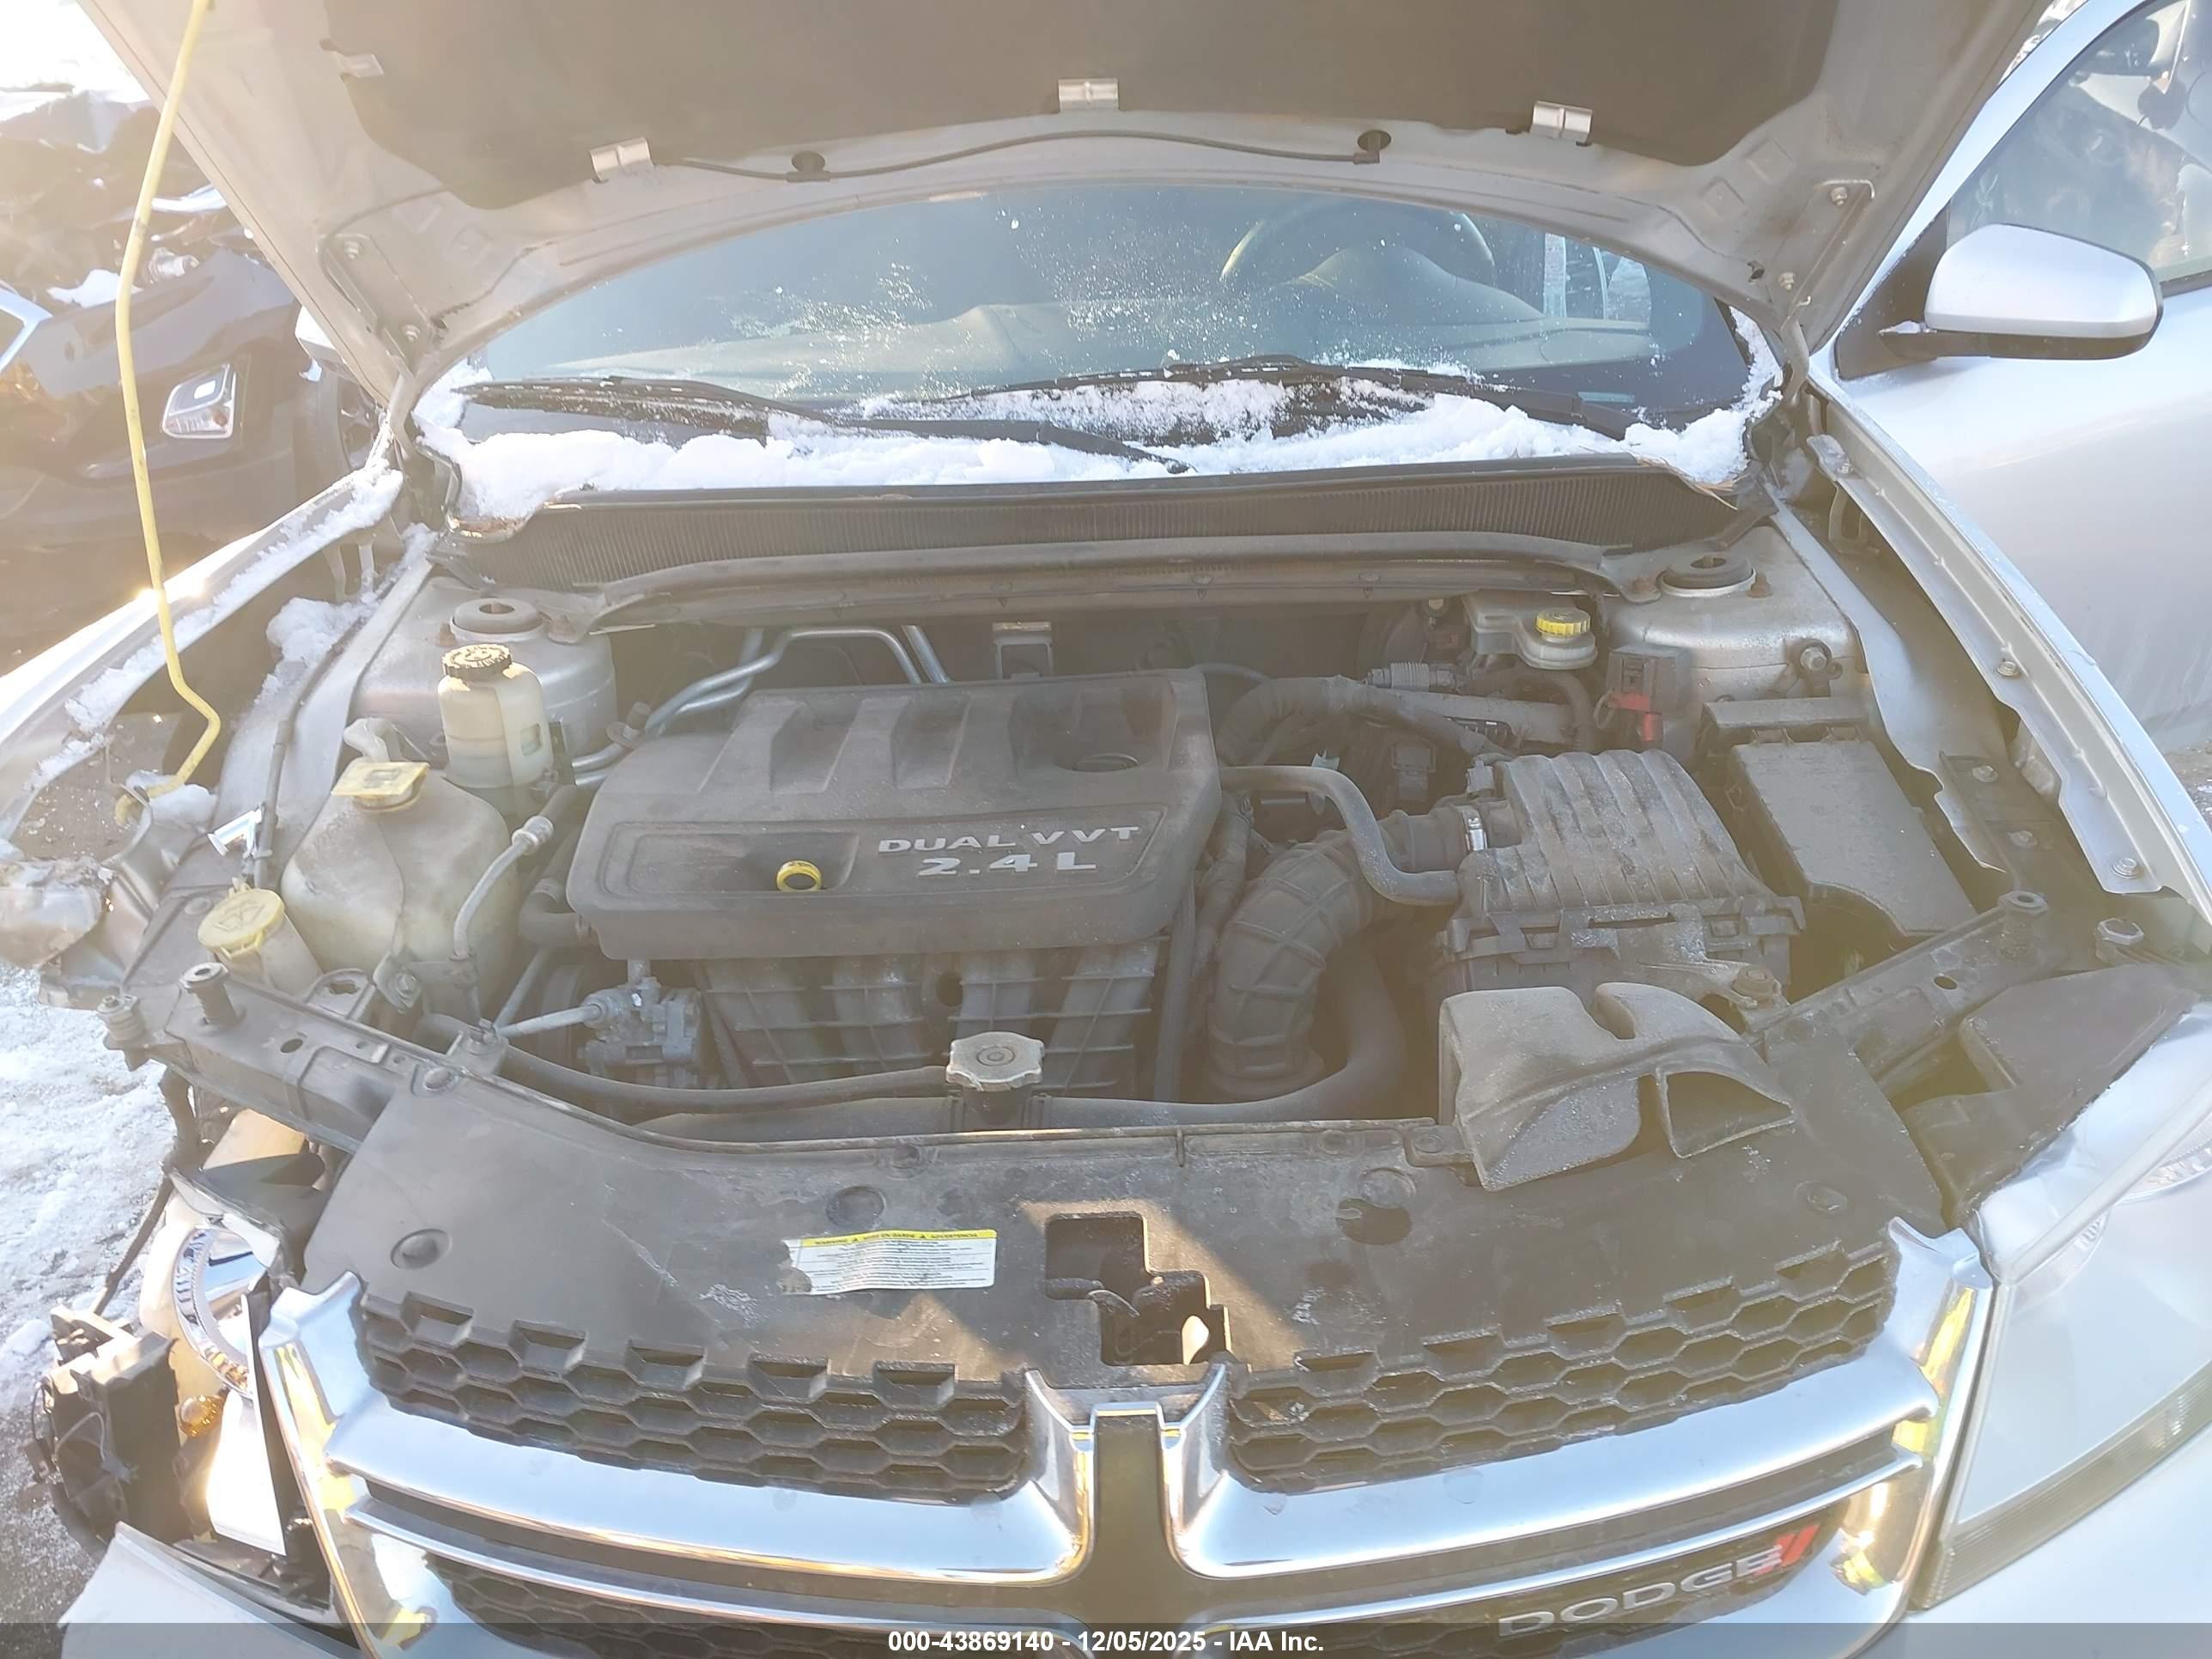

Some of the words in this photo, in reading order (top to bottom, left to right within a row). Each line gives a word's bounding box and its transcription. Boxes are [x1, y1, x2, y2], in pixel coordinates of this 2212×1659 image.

[878, 835, 1016, 853] DUAL
[1031, 826, 1139, 846] VVT
[1498, 1545, 1784, 1638] DODGE
